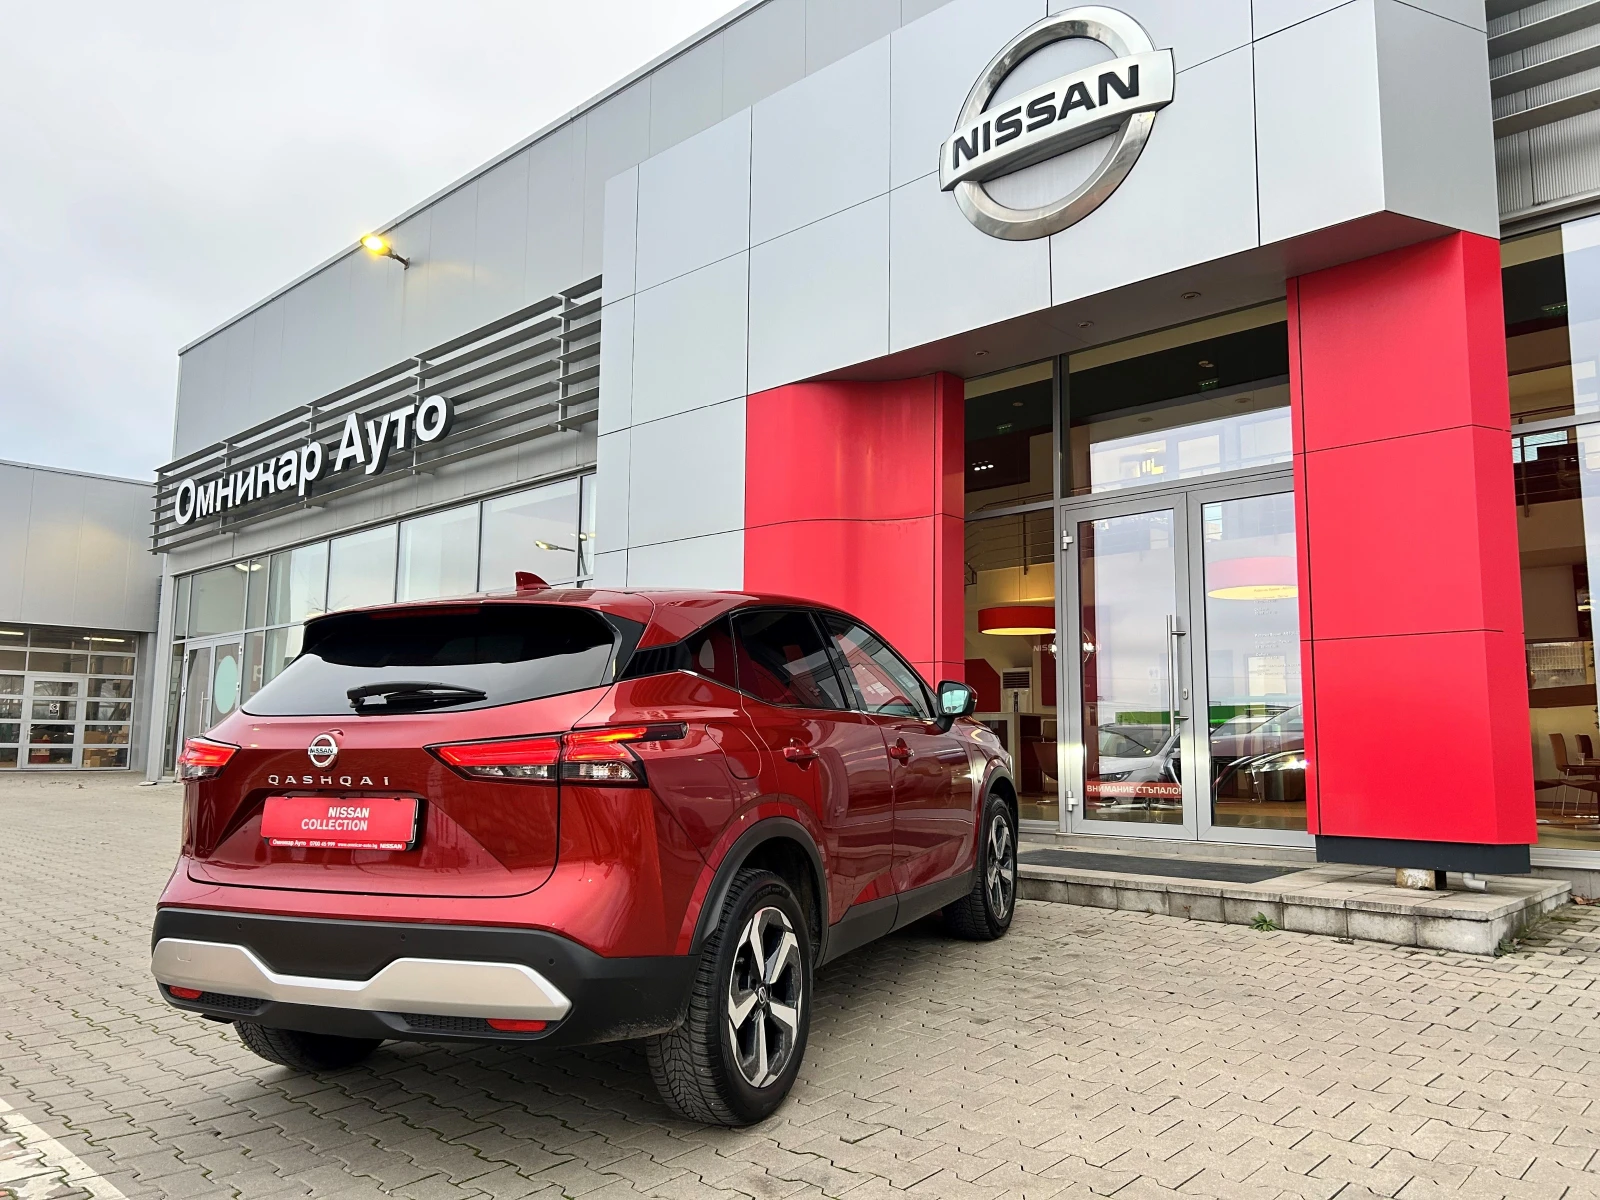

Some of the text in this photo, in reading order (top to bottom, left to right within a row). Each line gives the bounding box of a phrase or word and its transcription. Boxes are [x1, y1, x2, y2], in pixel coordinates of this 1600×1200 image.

[952, 64, 1140, 170] NISSAN
[174, 395, 450, 526] Омникар Ауто
[268, 774, 389, 787] QASHQAI
[1086, 785, 1182, 794] ВНИМАНИЕ СТЪПАЛО!
[328, 806, 370, 819] NISSAN
[301, 818, 368, 831] COLLECTION
